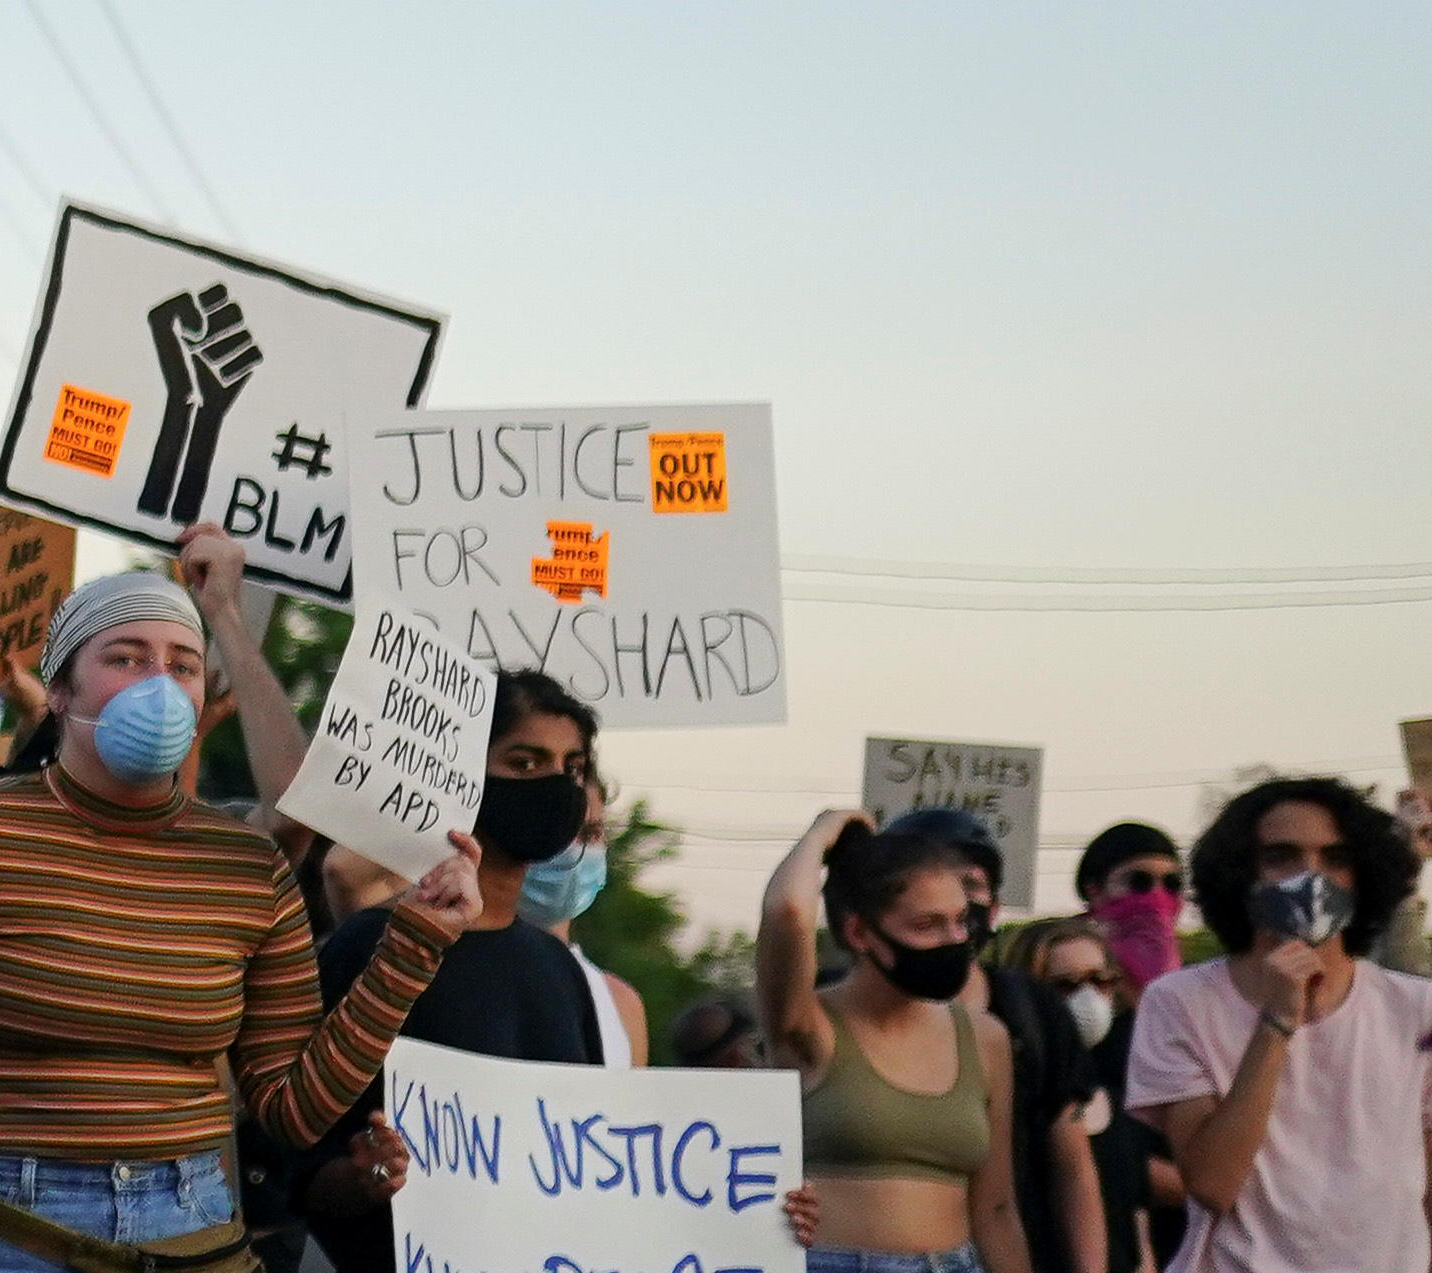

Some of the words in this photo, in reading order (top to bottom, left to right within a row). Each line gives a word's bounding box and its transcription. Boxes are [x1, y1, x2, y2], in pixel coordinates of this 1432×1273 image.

[62, 408, 116, 437] Pence
[64, 388, 126, 420] Trump/
[52, 427, 90, 447] MUST
[94, 439, 117, 457] GO!
[272, 422, 332, 480] #
[375, 422, 650, 506] JUSTICE
[659, 452, 717, 478] OUT
[223, 475, 347, 564] BLM
[655, 480, 723, 503] NOW
[393, 525, 501, 590] FOR
[534, 566, 575, 581] MUST
[554, 549, 600, 563] ence
[369, 610, 486, 718] RAYSHARD
[412, 607, 781, 701] AYSHARD
[381, 679, 462, 763] BROOKS
[327, 703, 374, 752] WAS
[382, 734, 481, 810] MURDERD
[334, 755, 372, 792] BY
[379, 781, 440, 833] APD
[390, 1071, 503, 1185] KNOW
[528, 1096, 782, 1215] JUSTICE
